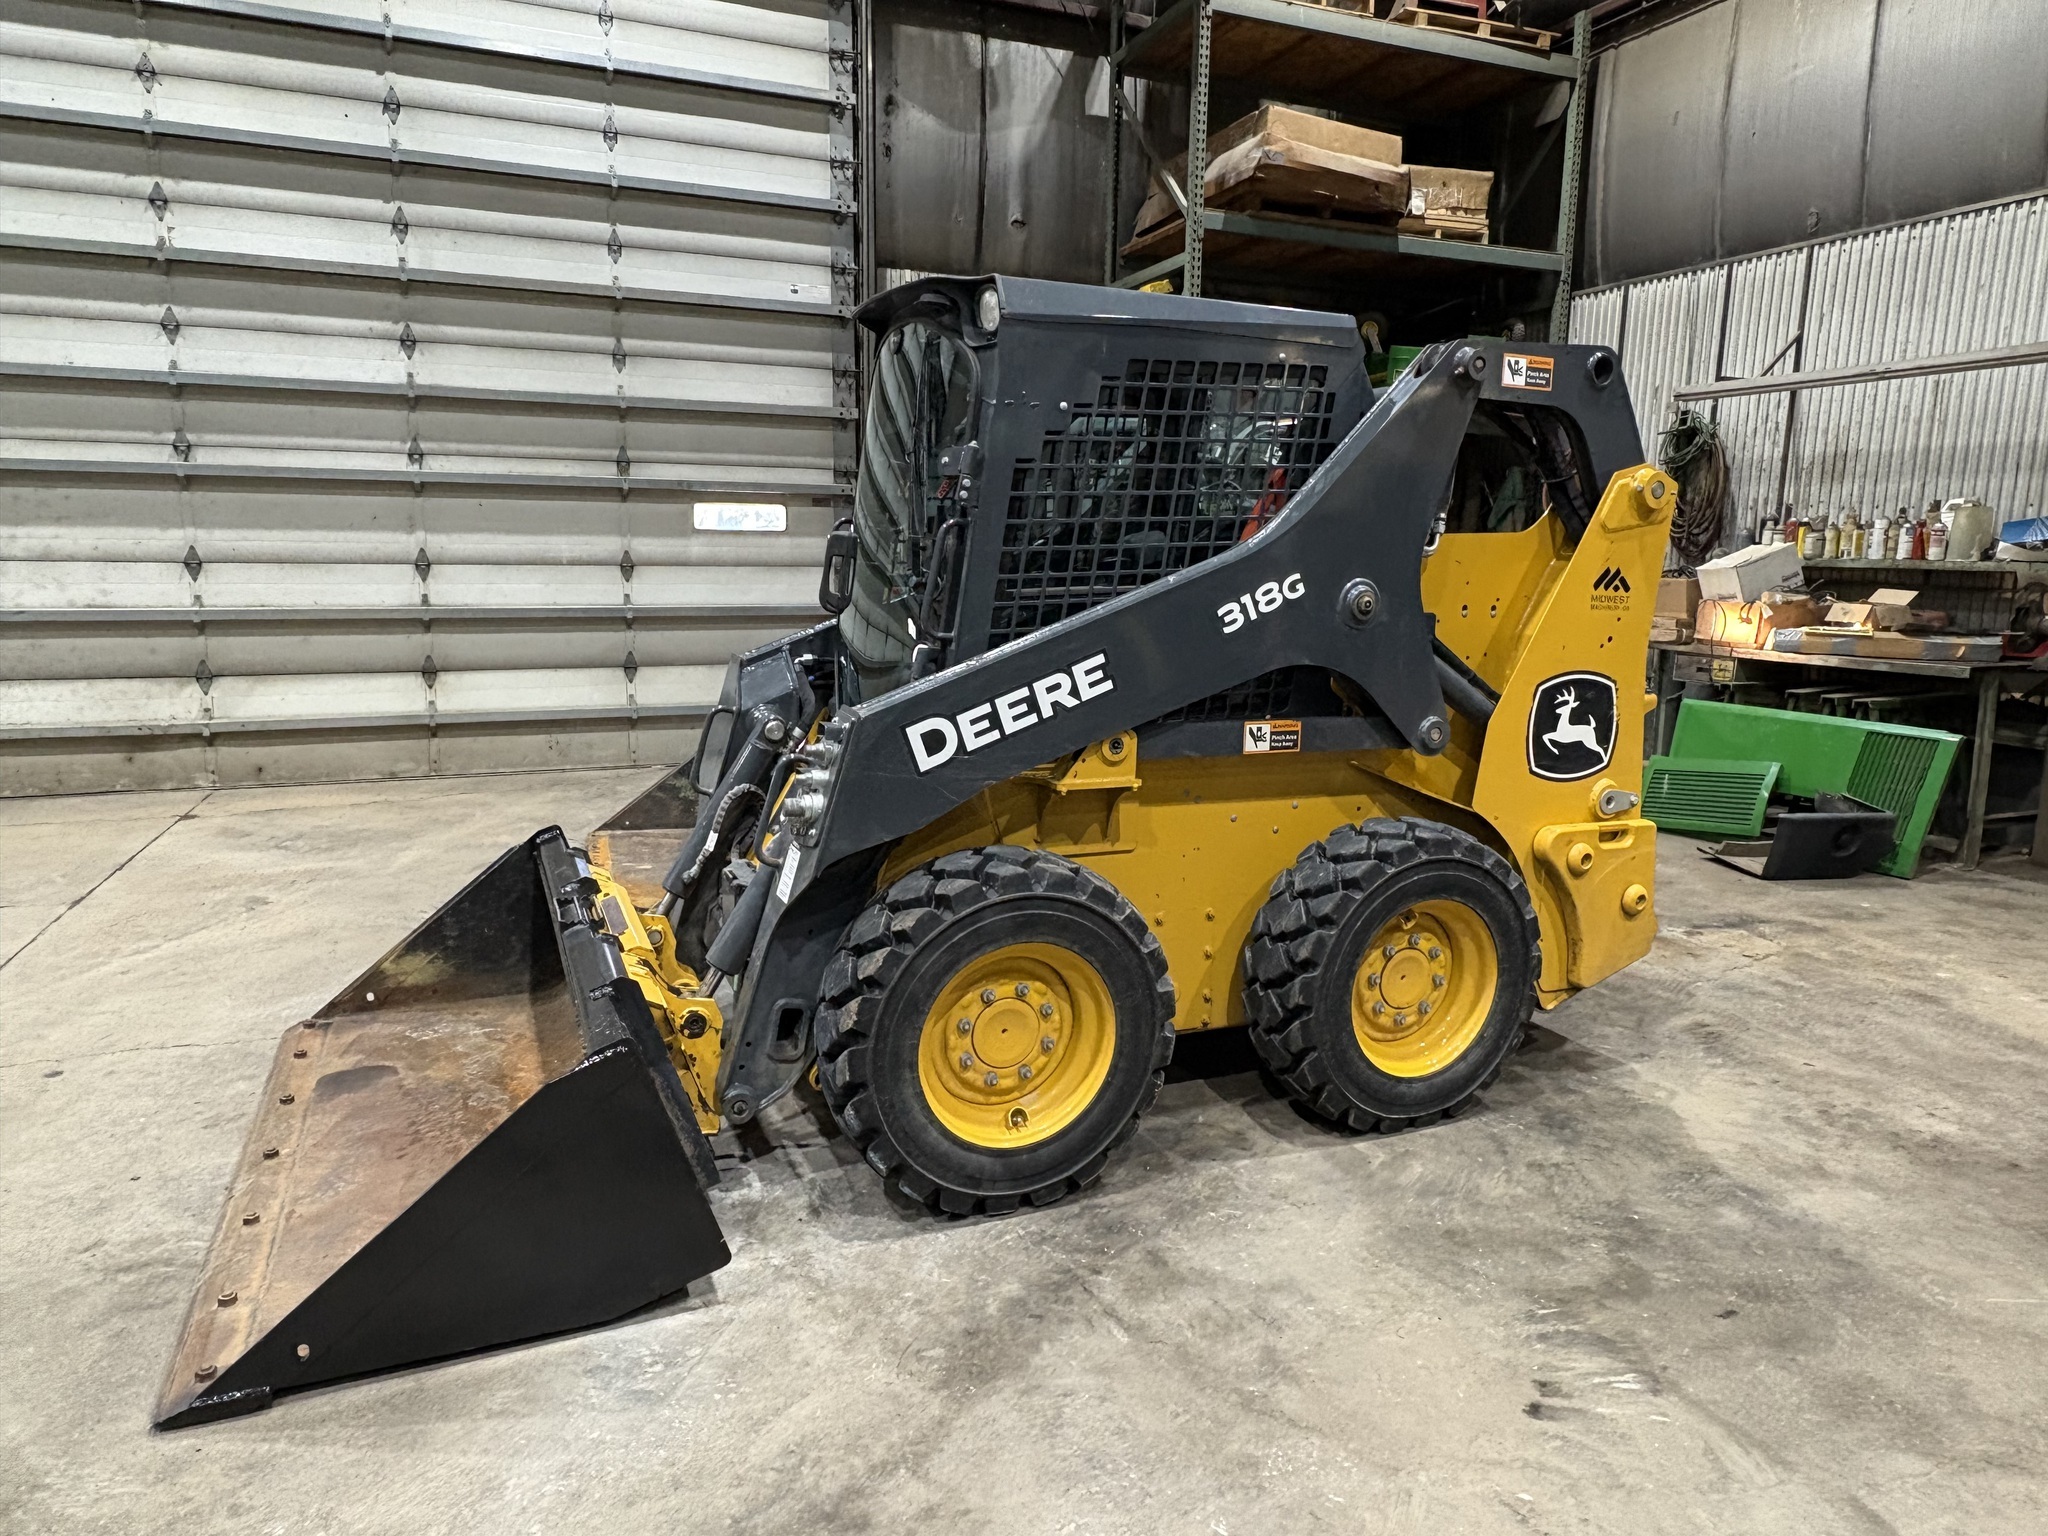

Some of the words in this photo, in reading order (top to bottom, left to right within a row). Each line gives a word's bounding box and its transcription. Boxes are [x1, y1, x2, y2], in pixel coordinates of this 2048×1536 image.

[1216, 572, 1306, 634] 318G
[1590, 594, 1630, 605] MIDWEST
[905, 652, 1114, 773] DEERE
